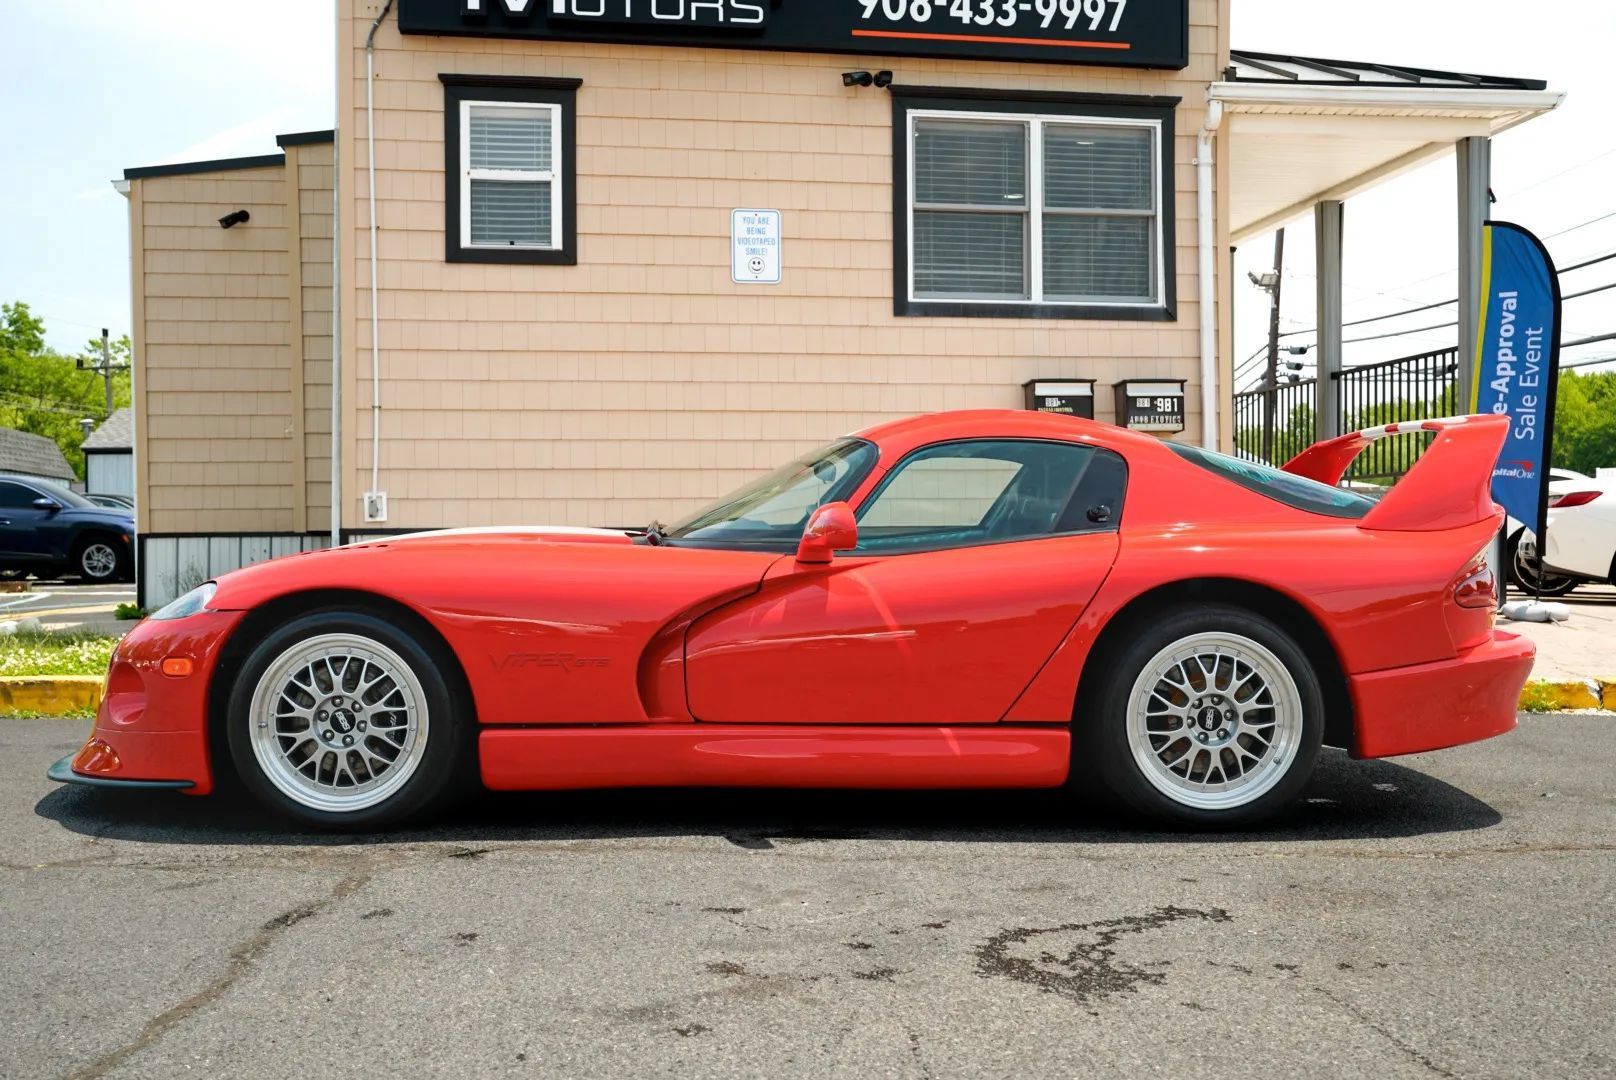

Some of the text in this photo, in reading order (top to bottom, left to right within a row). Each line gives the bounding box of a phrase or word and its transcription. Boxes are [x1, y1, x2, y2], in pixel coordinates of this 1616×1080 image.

[467, 0, 764, 24] OORS
[758, 217, 769, 225] ARE
[747, 227, 766, 235] BEING
[738, 237, 776, 245] VIDEOTAPED
[745, 248, 768, 256] SMILE!
[1490, 291, 1519, 415] e-Approval
[1515, 327, 1544, 440] Sale Event
[1157, 398, 1178, 412] 981
[488, 652, 613, 674] VIPER GTS
[335, 711, 350, 731] BBS
